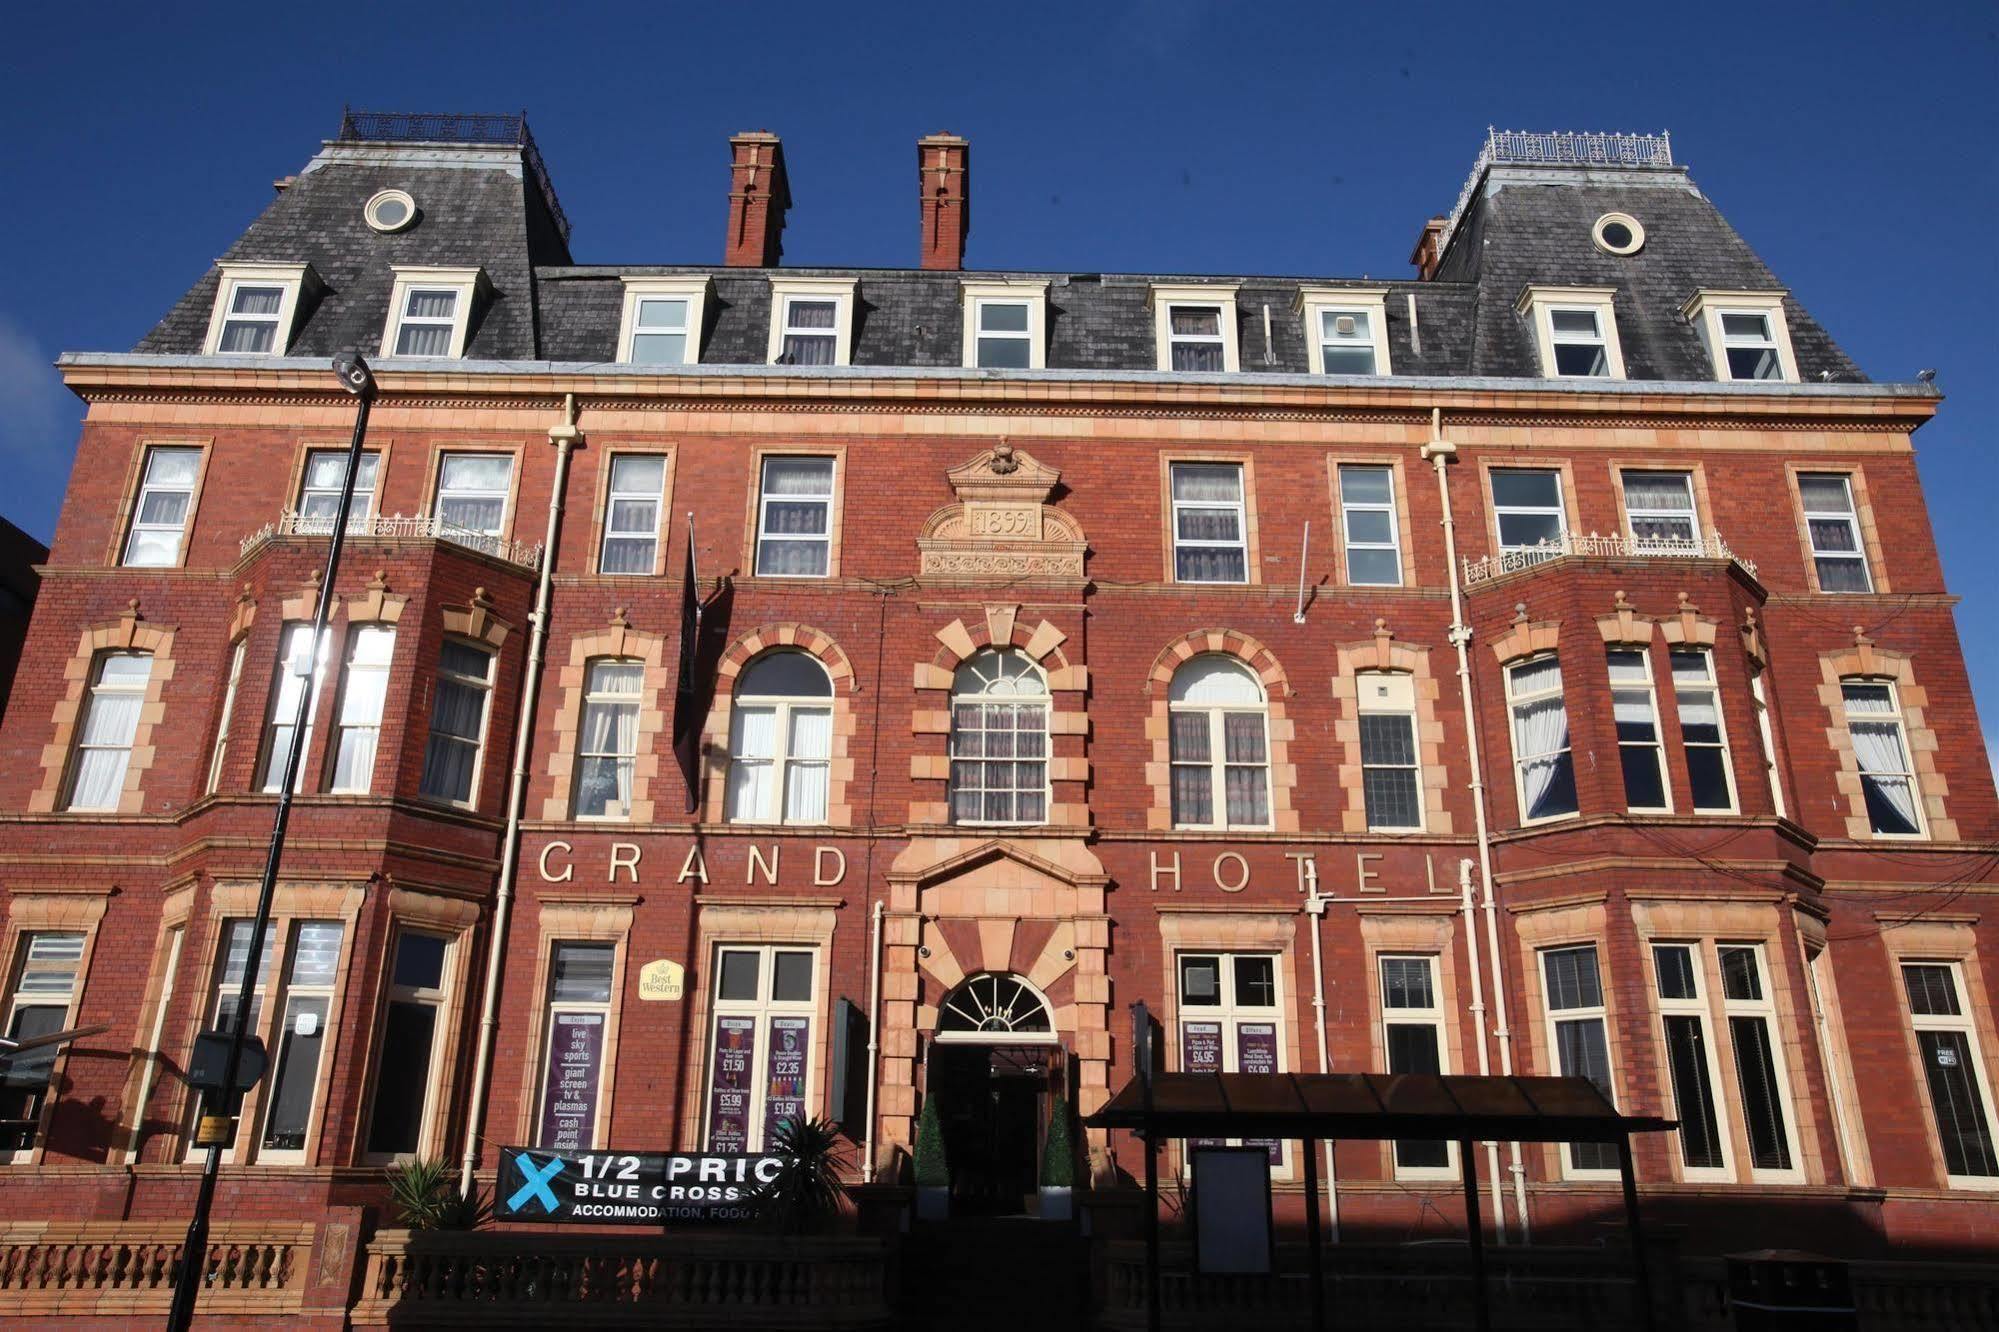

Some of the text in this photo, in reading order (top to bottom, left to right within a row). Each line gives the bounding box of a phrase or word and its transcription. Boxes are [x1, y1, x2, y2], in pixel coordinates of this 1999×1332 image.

[978, 511, 1029, 534] 1899
[539, 841, 1453, 893] GRAND HOTEL
[651, 973, 671, 984] Best
[642, 982, 680, 993] Western
[572, 1028, 586, 1038] live
[571, 1039, 585, 1052] sky
[564, 1051, 589, 1062] sports
[1193, 1051, 1214, 1063] £4.95
[723, 1059, 744, 1071] £1.50
[776, 1062, 799, 1074] £2.35
[564, 1067, 585, 1079] giant
[560, 1080, 587, 1089] screen
[720, 1094, 742, 1106] £5.99
[554, 1100, 588, 1113] plasmas
[774, 1103, 796, 1115] £1.50
[559, 1118, 579, 1128] cash
[557, 1129, 578, 1142] point
[554, 1140, 579, 1149] inside
[578, 1154, 797, 1183] 1/2 PRIC
[575, 1183, 640, 1199] BLUE
[651, 1185, 739, 1201] CROSS
